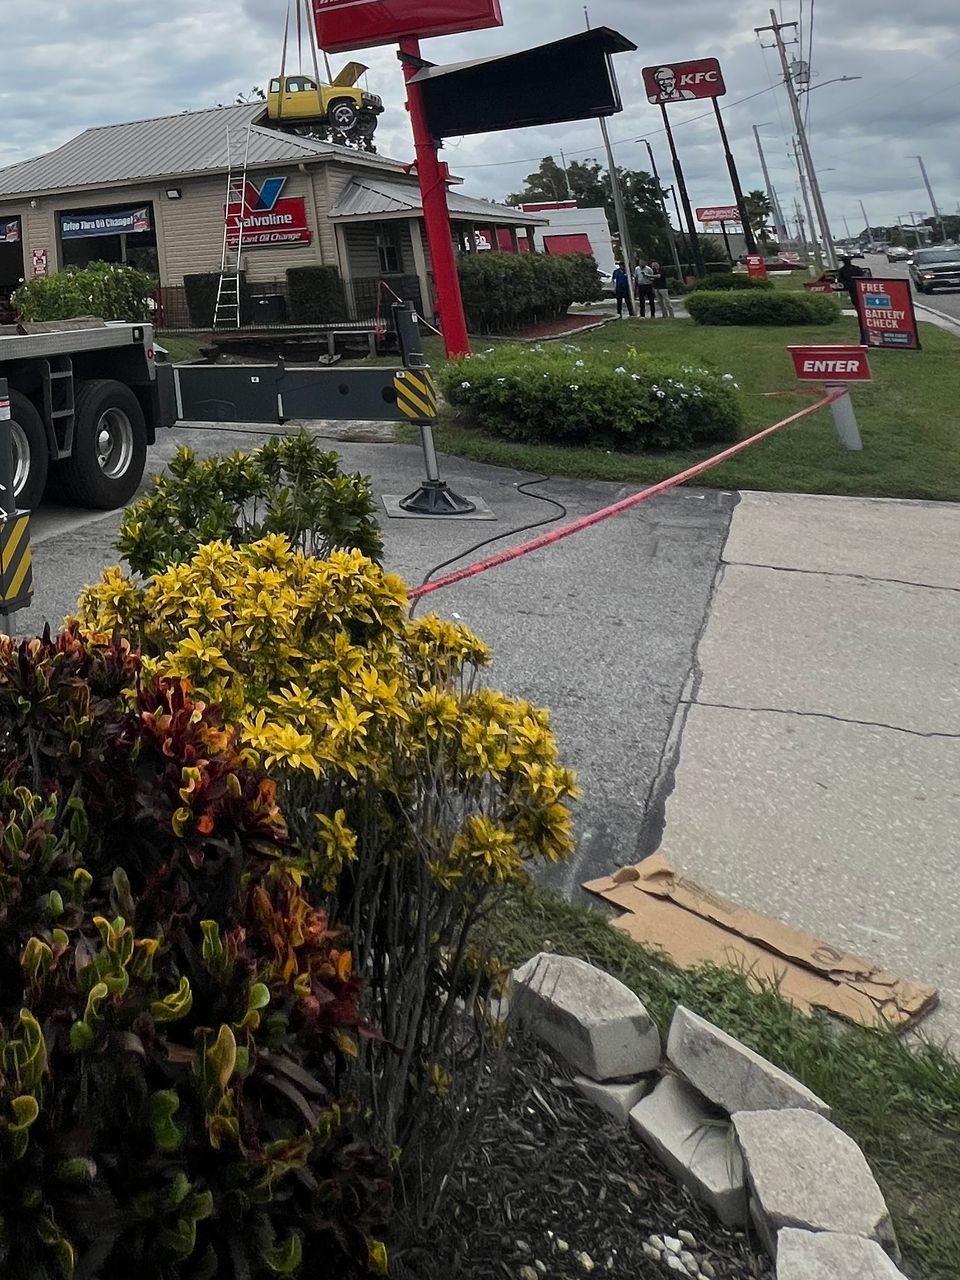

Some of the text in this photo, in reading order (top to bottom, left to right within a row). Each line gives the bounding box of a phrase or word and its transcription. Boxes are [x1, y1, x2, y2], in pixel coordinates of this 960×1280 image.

[680, 71, 717, 86] KFC
[259, 234, 270, 242] Oil
[270, 233, 301, 241] Change
[860, 283, 885, 292] FREE
[865, 309, 905, 320] BATTERY
[866, 319, 899, 328] CHECK
[803, 360, 860, 372] ENTER
